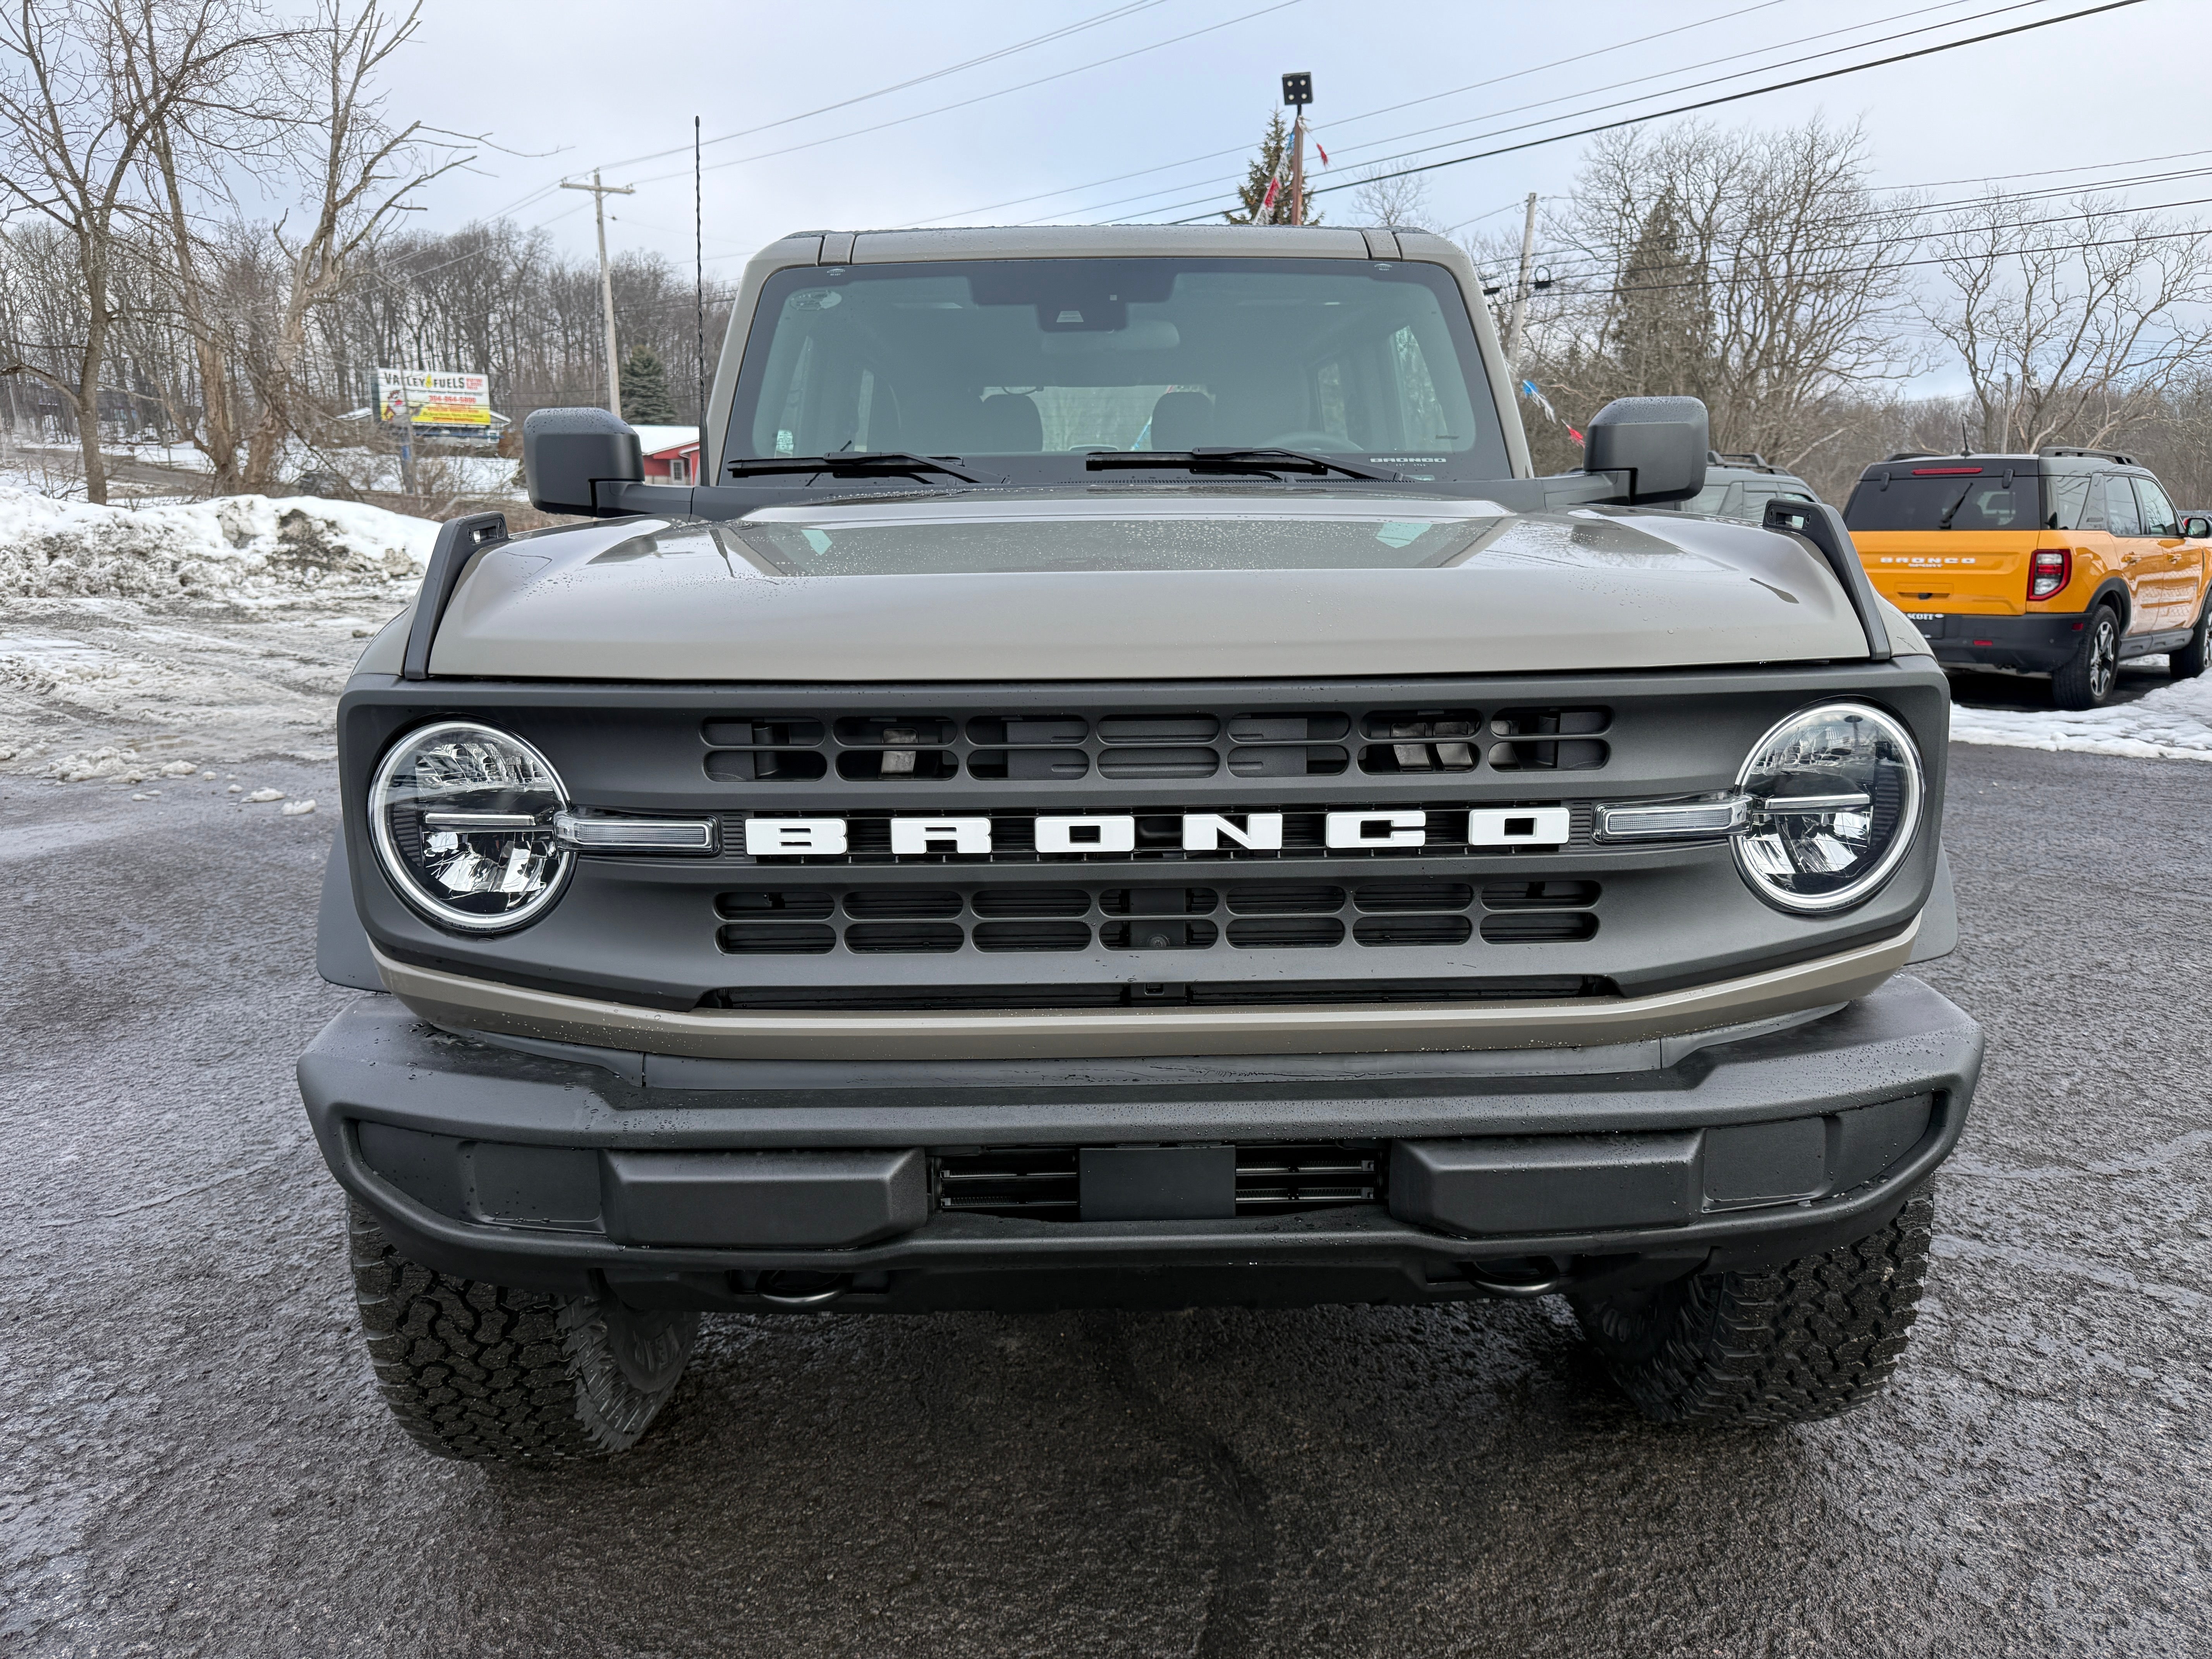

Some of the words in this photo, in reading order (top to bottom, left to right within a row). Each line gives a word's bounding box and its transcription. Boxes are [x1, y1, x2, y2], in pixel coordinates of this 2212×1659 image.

[384, 372, 425, 387] VALEY
[434, 377, 464, 389] FUELS
[745, 807, 1570, 855] BRONCO
